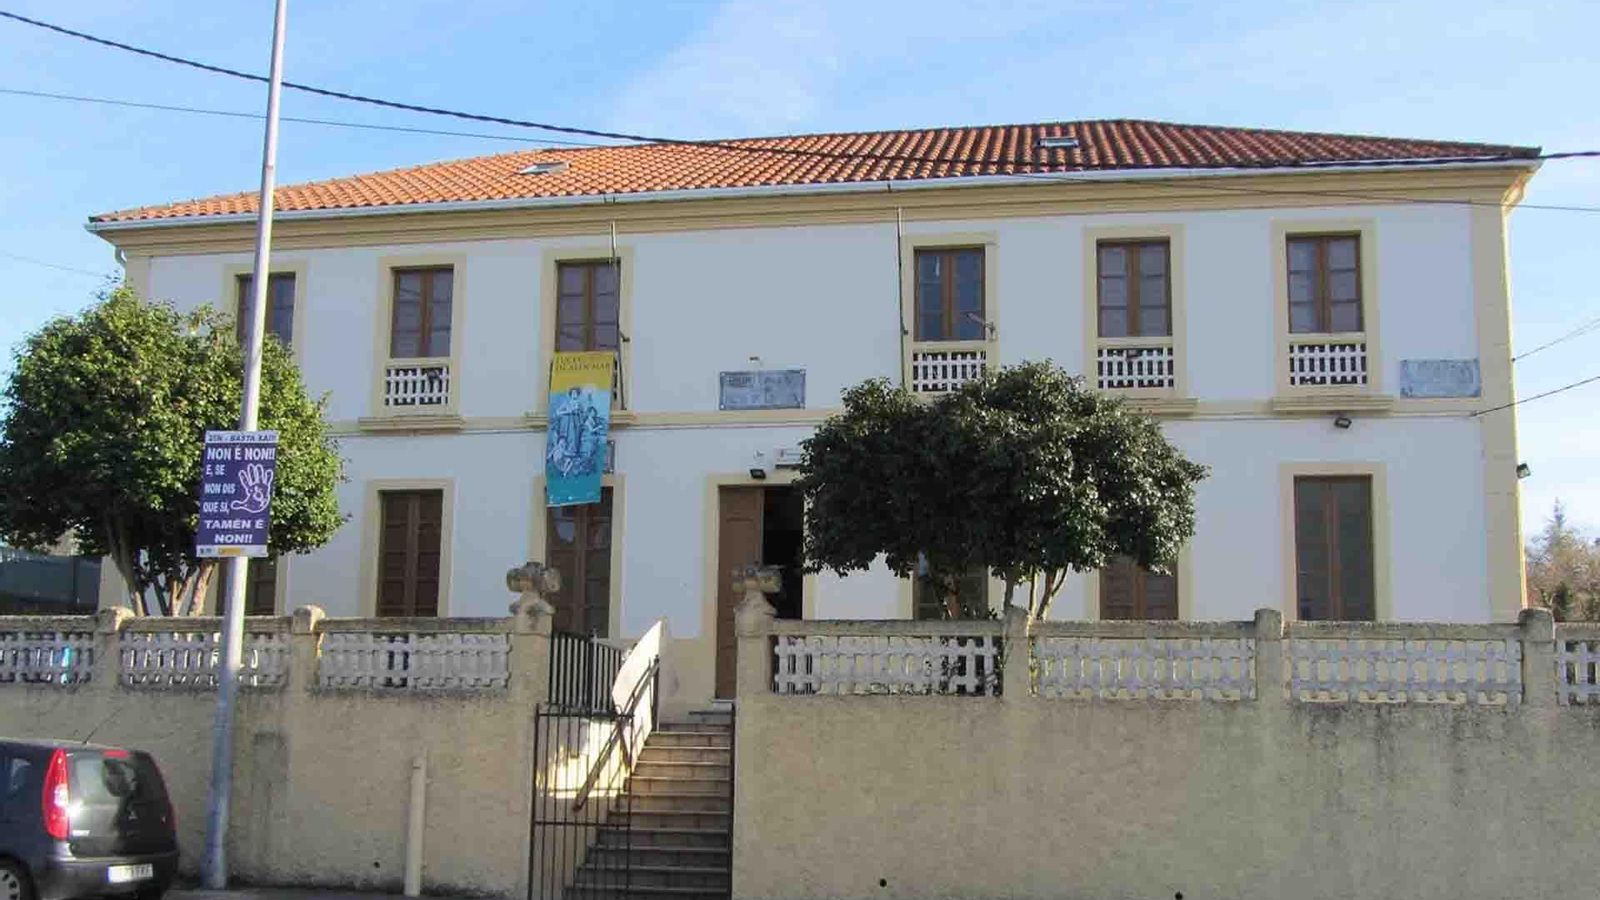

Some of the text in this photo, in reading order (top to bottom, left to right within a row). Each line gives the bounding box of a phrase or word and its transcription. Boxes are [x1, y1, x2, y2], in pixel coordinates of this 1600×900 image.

[207, 447, 232, 460] NON
[244, 447, 276, 461] NON!!
[215, 464, 226, 476] SE
[204, 483, 236, 494] NON DIS
[203, 501, 219, 513] QUE
[214, 534, 253, 544] NON!!
